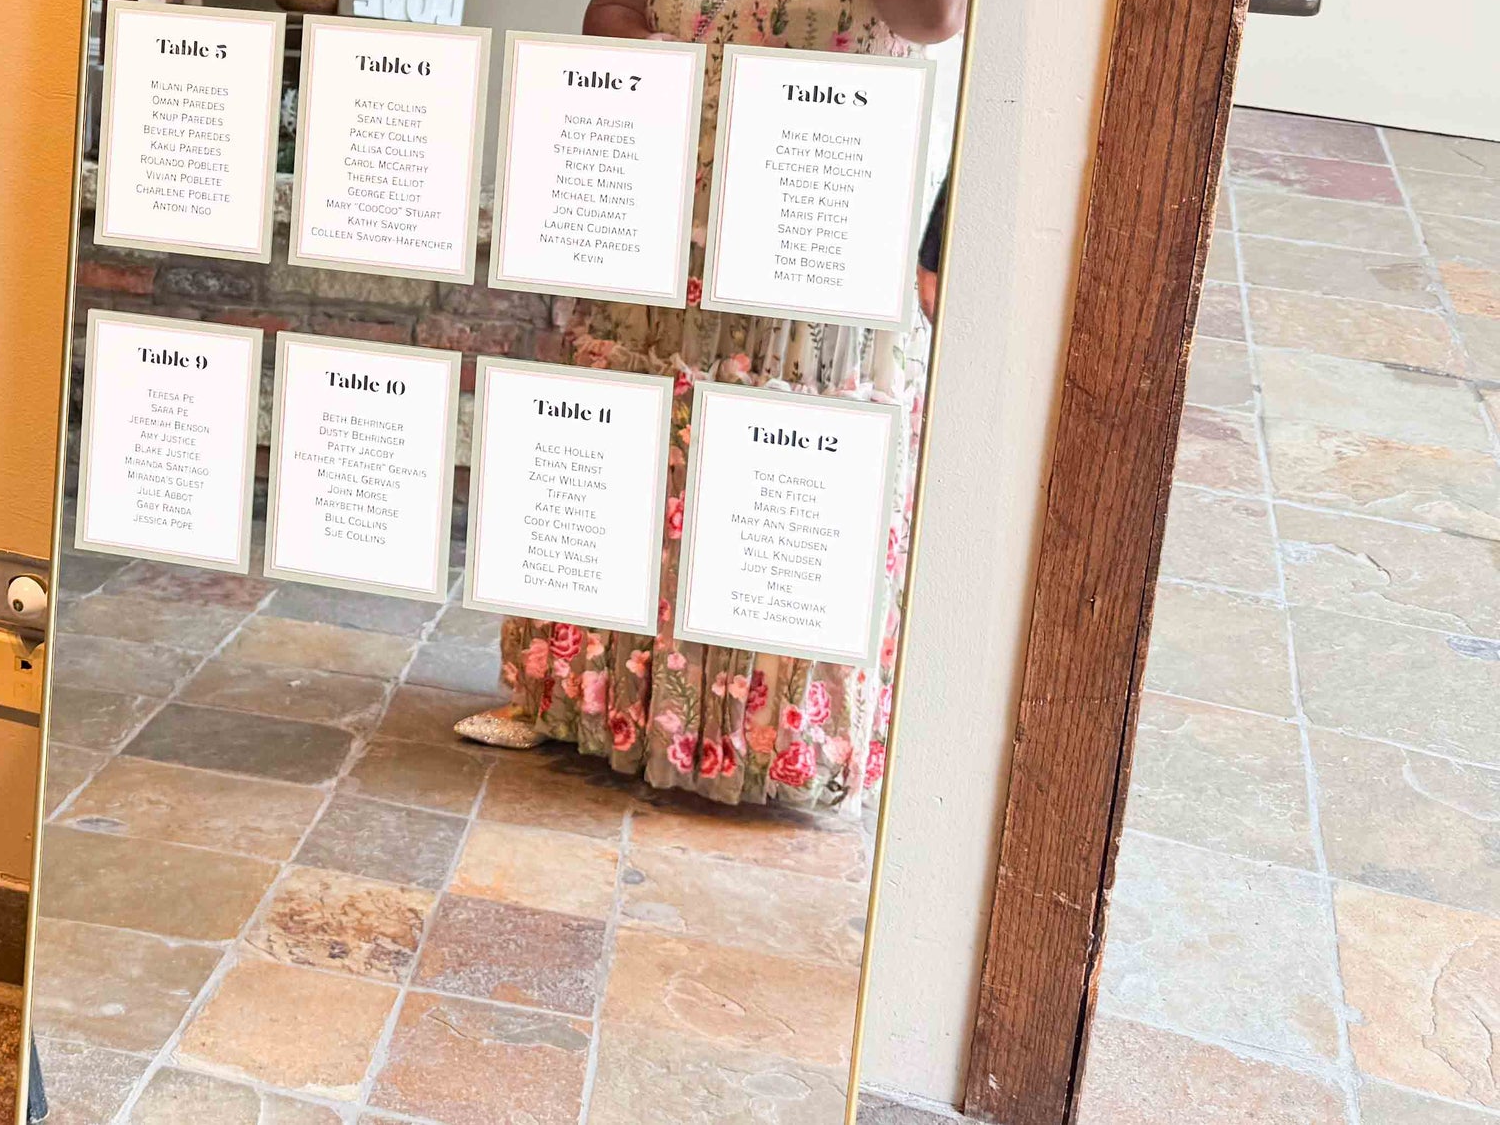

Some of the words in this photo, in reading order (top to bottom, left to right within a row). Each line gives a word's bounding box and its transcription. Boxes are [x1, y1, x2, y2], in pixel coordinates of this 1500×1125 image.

[156, 39, 209, 57] Table
[215, 44, 228, 59] 5
[355, 55, 412, 75] Table
[418, 59, 432, 76] 6
[563, 70, 623, 90] Table
[629, 76, 642, 91] 7
[782, 84, 846, 105] Table
[138, 347, 189, 368] Table
[196, 355, 211, 370] 9
[325, 371, 380, 392] Table
[386, 379, 405, 396] 10
[533, 399, 593, 421] Table
[598, 407, 611, 423] 11
[748, 426, 809, 449] Table
[817, 435, 838, 452] 12
